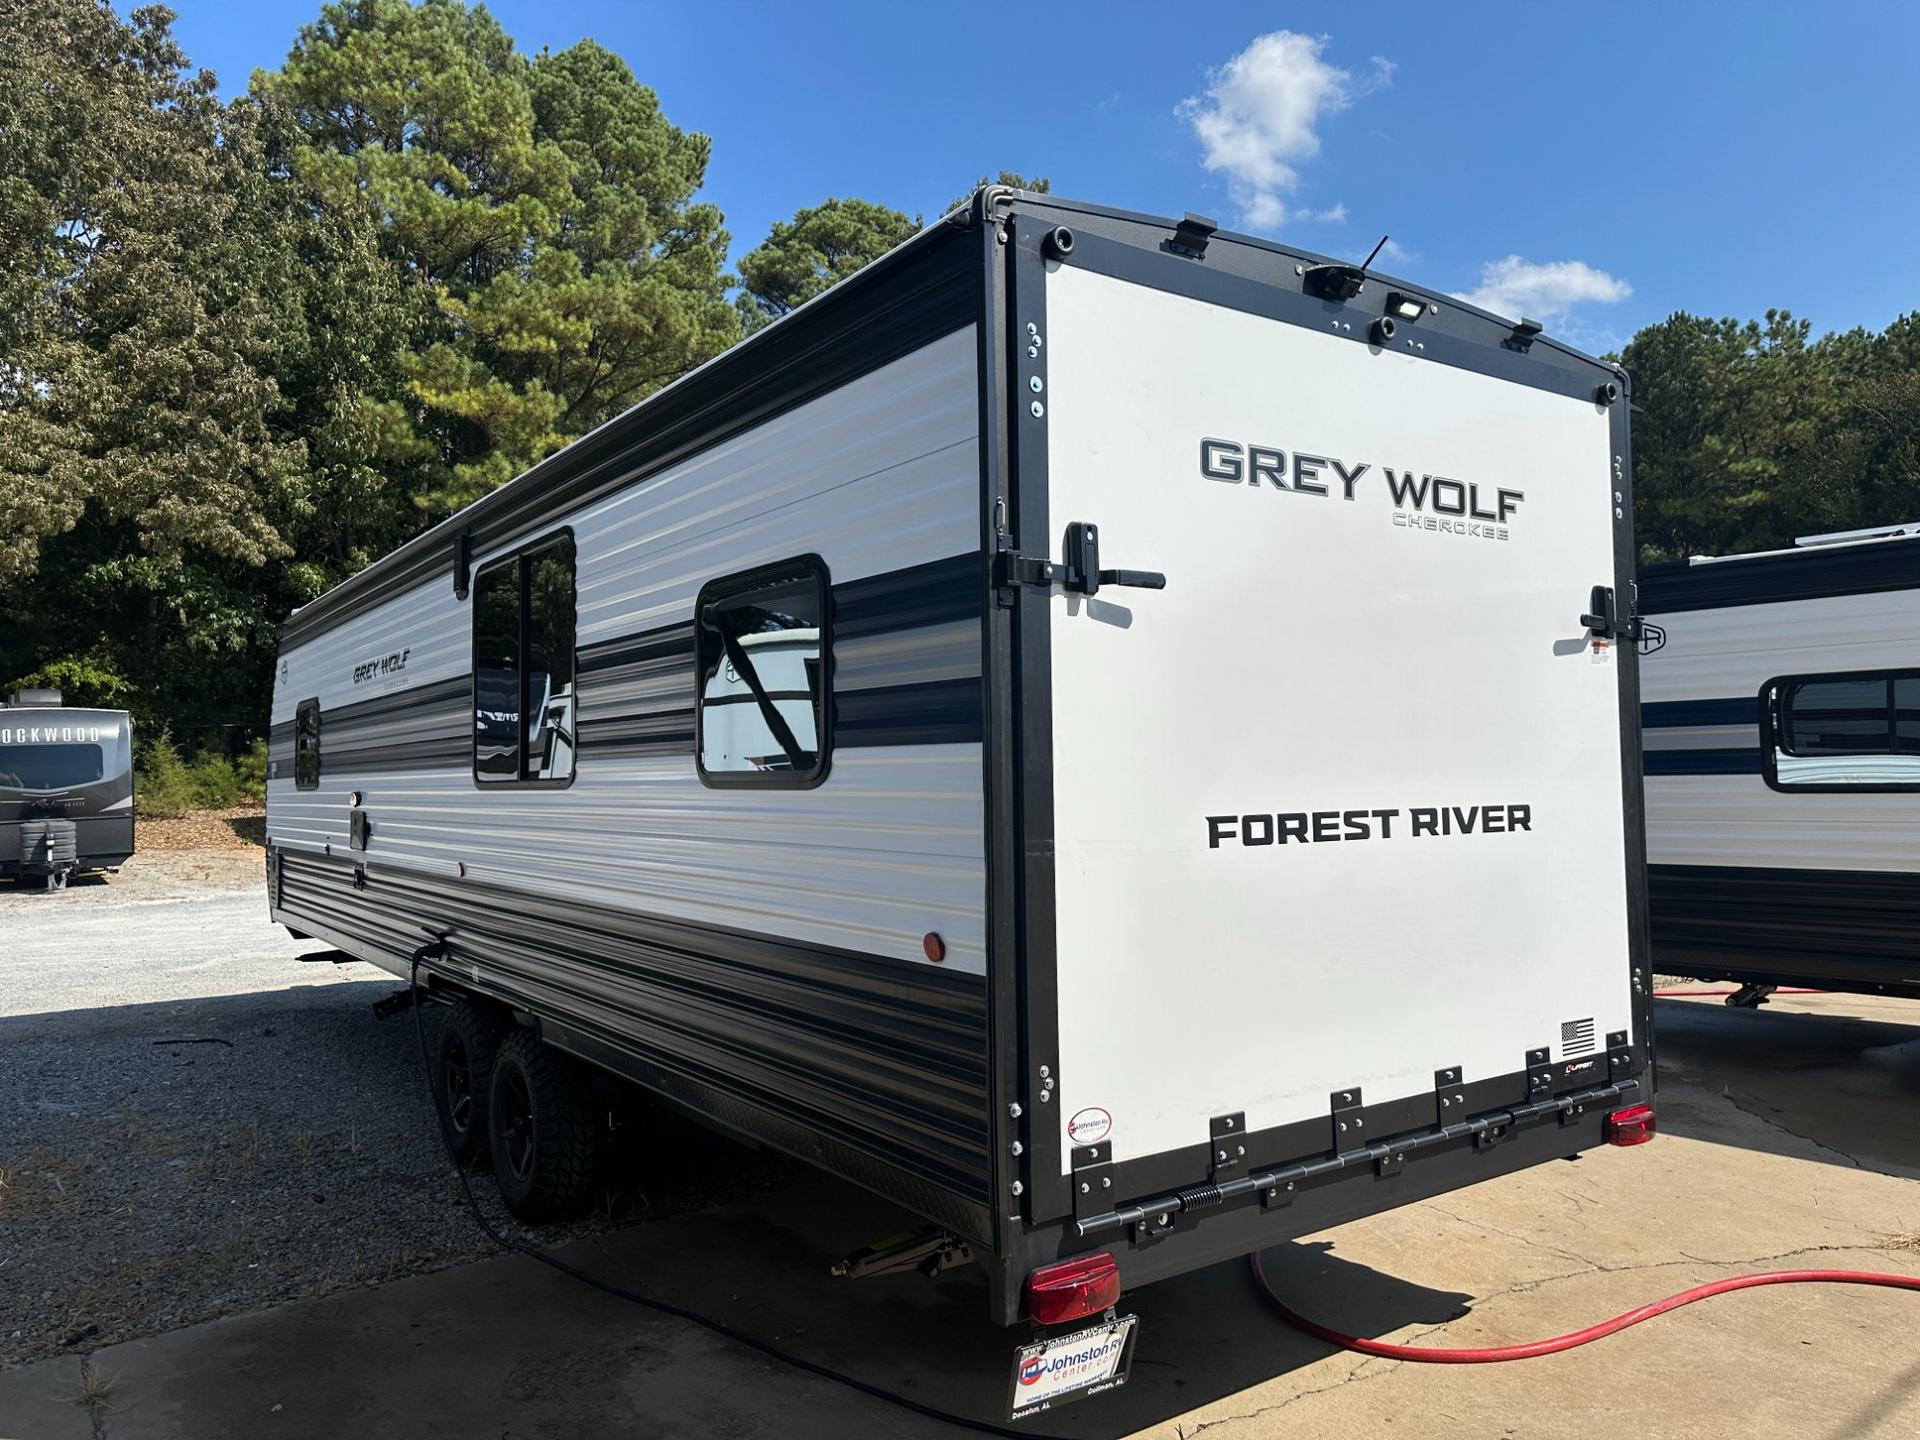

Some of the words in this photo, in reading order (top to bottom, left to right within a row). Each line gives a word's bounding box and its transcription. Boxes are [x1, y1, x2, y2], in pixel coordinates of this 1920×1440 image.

[1199, 436, 1372, 501] GREY
[1383, 465, 1525, 524] WOLF
[1392, 511, 1510, 541] CHEROKEE
[353, 659, 379, 684] GREY
[381, 648, 410, 674] WOLF
[1204, 809, 1400, 849] FOREST
[1408, 804, 1532, 837] RIVER
[1047, 1344, 1109, 1373] Johnston
